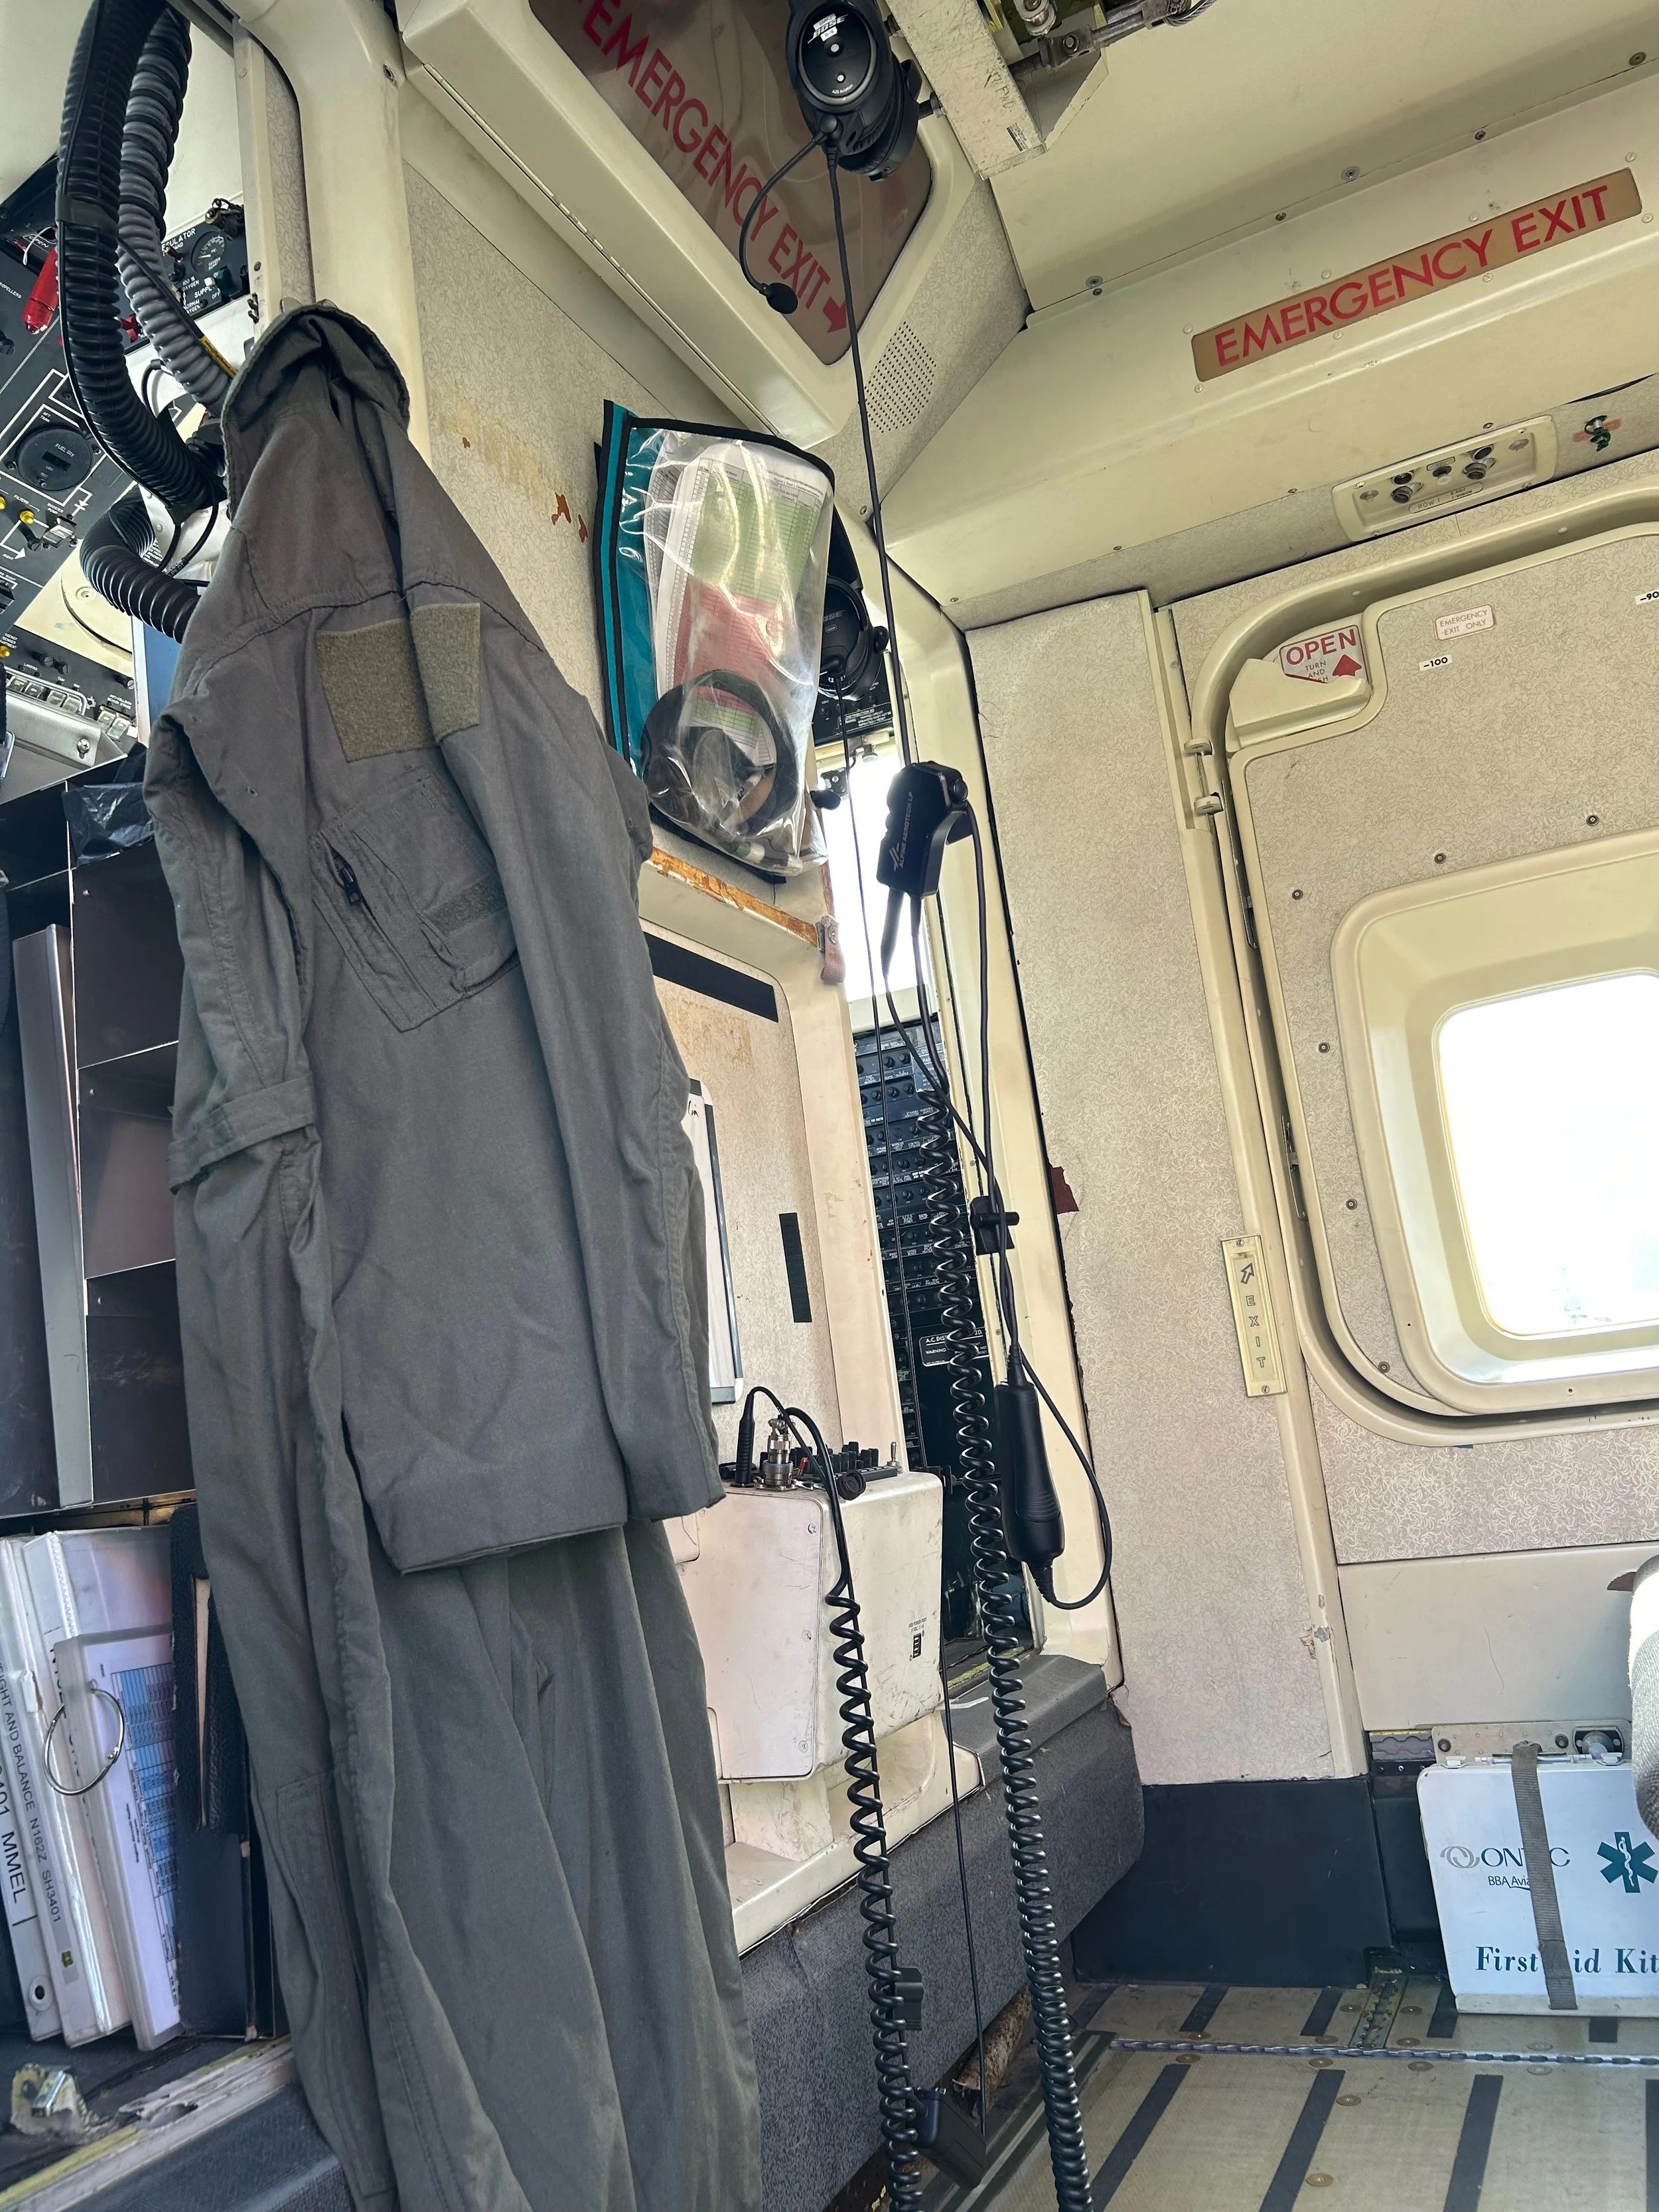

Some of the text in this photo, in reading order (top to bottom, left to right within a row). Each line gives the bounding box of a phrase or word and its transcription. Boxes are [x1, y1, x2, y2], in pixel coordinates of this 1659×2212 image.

[811, 15, 847, 39] BOSE
[581, 0, 831, 309] EMERGENCY EXIT
[1215, 184, 1609, 366] EMERGENCY EXIT
[0, 281, 22, 299] ROPELLERS
[194, 285, 216, 299] SUPPL
[54, 443, 66, 453] FUEL
[1417, 499, 1435, 510] ROW
[1440, 609, 1488, 627] EMERGENCY
[1444, 619, 1486, 635] EXIT ONLY
[1286, 628, 1356, 665] OPEN
[1305, 660, 1327, 672] TURN
[1308, 668, 1325, 679] AND
[903, 802, 912, 841] AEROTECH
[908, 790, 914, 801] LP
[1246, 1295, 1265, 1368] EXIT
[0, 1660, 61, 1923] EIGHT AND BALANCE N162Z SH3401
[1, 1831, 26, 1903] MMEL
[1481, 1847, 1570, 1867] ONC
[1488, 1876, 1509, 1887] BBA
[1476, 1946, 1659, 1974] First id Kit
